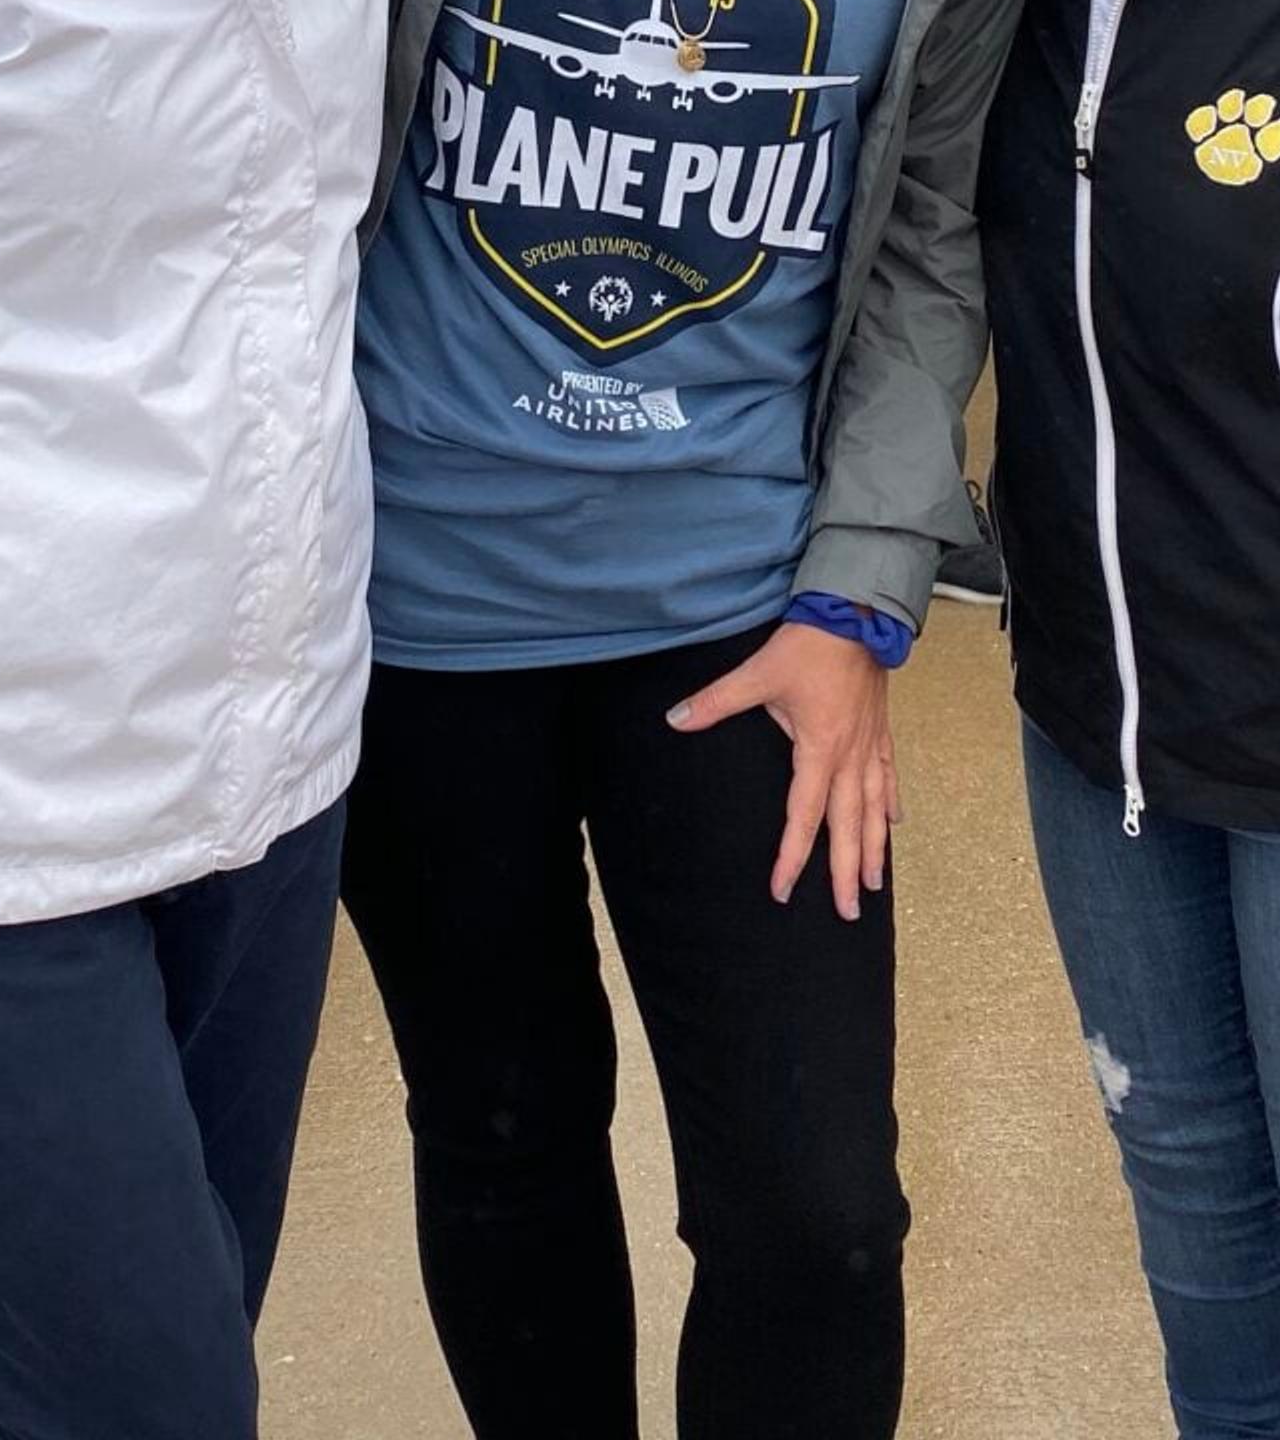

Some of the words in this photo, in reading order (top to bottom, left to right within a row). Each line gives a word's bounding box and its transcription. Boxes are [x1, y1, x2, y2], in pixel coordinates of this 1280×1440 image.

[424, 58, 657, 221] PLANE
[658, 127, 832, 252] PULL
[521, 238, 580, 269] SPECIAL
[581, 236, 652, 262] OLYMPICS
[655, 250, 710, 294] ILLINOIS
[512, 393, 649, 432] AIRLINES
